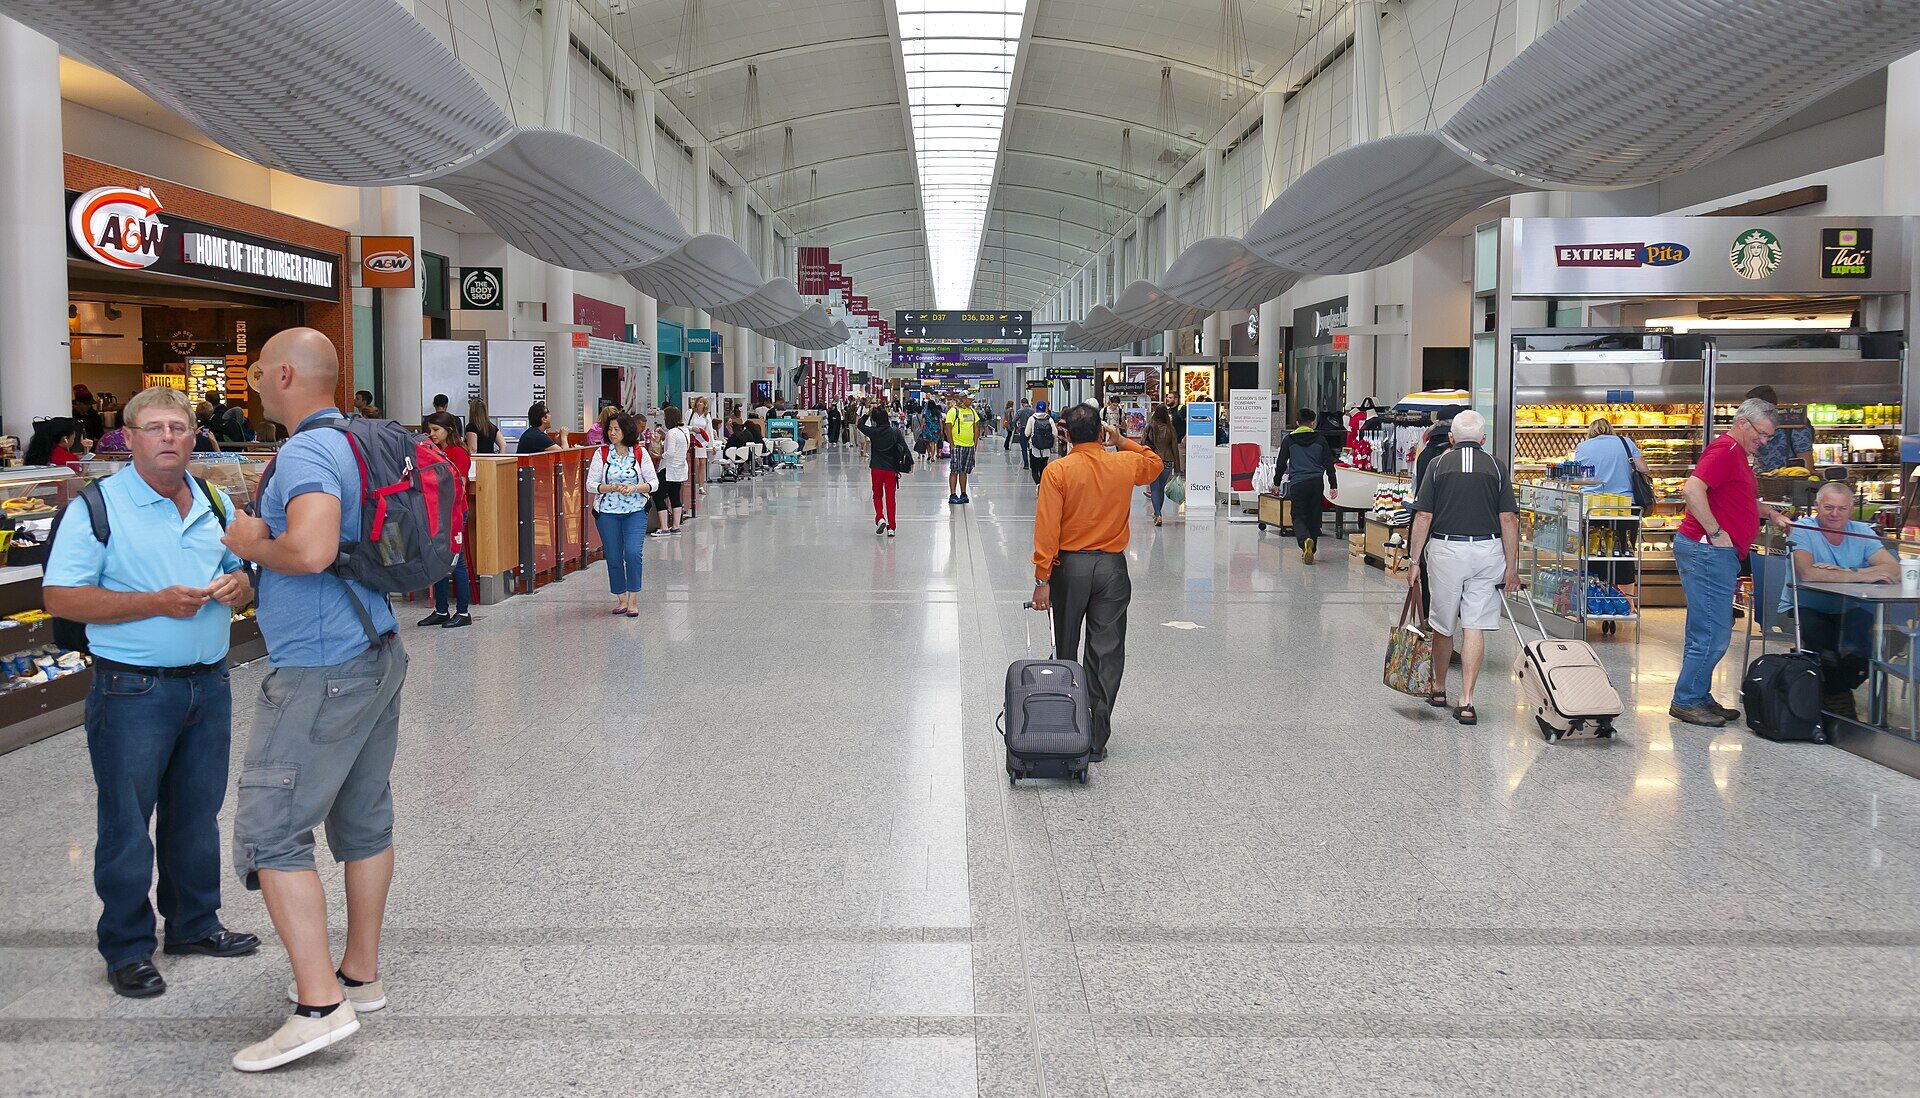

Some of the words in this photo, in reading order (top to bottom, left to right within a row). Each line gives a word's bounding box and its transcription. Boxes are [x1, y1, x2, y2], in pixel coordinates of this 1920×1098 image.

[97, 213, 168, 256] A&W
[196, 233, 228, 268] HOME
[230, 240, 243, 271] OF
[245, 244, 264, 276] THE
[266, 249, 302, 282] BURGER
[302, 256, 332, 288] FAMILY
[372, 260, 408, 268] A&W
[1560, 248, 1636, 260] EXTREME
[1646, 246, 1684, 264] Pita
[1831, 266, 1866, 274] express
[236, 320, 246, 332] ICE
[237, 334, 246, 353] COLD
[468, 345, 480, 376] ORDER
[533, 346, 545, 376] ORDER
[150, 376, 171, 387] MUG
[226, 354, 248, 401] ROOT
[468, 383, 480, 404] ELF
